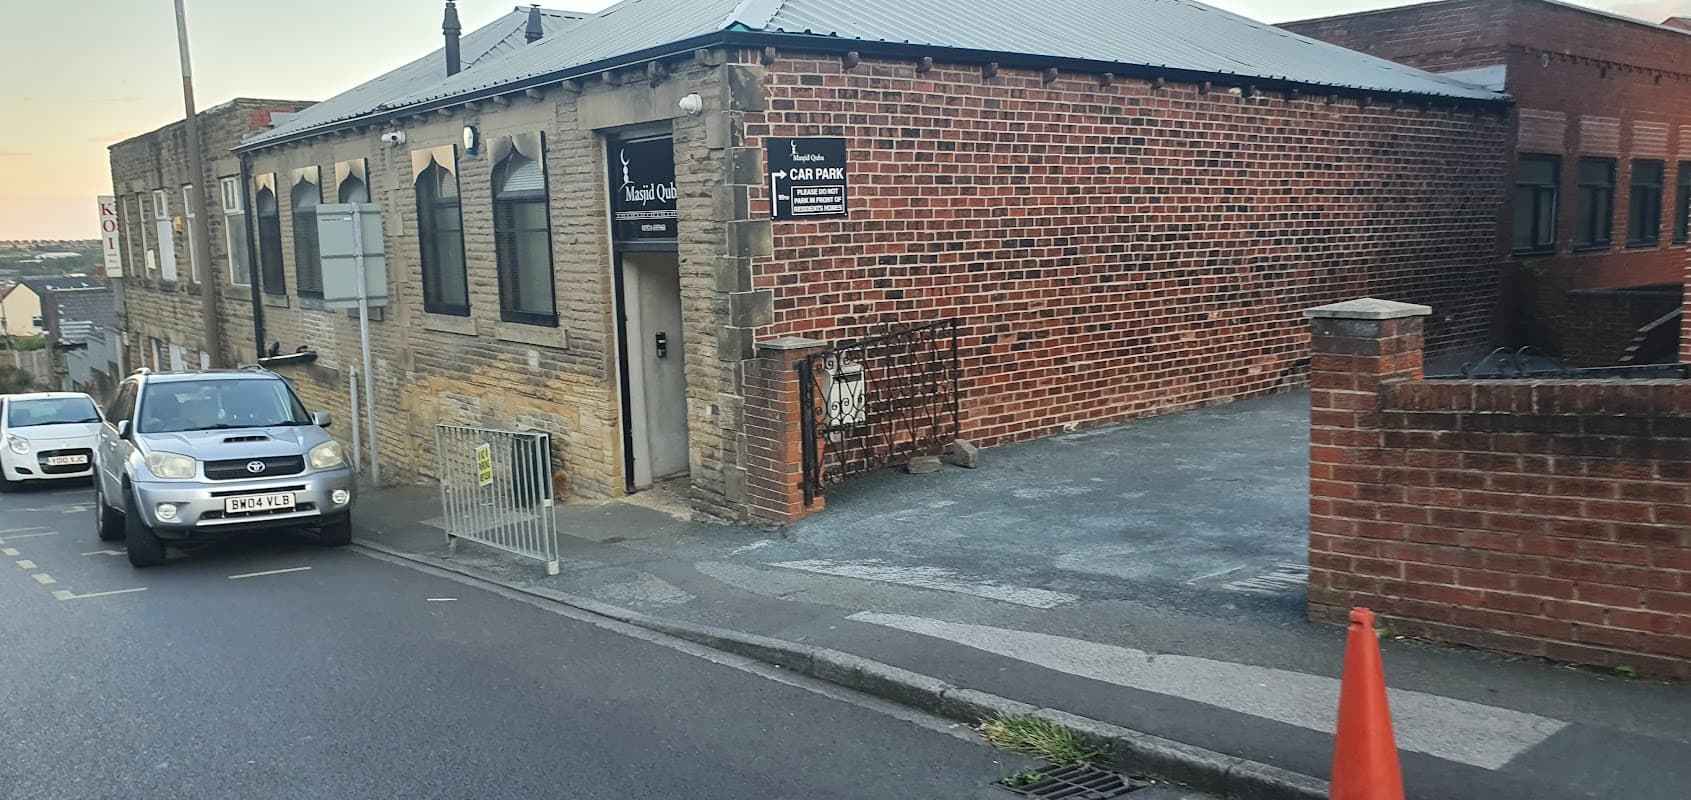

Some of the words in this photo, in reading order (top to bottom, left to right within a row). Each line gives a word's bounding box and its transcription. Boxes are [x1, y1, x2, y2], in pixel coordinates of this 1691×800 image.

[790, 168, 813, 180] CAR
[815, 168, 844, 180] PARK
[625, 183, 655, 206] Masjid
[656, 182, 677, 203] Qub
[231, 497, 263, 510] BW04
[266, 495, 290, 507] VLB
